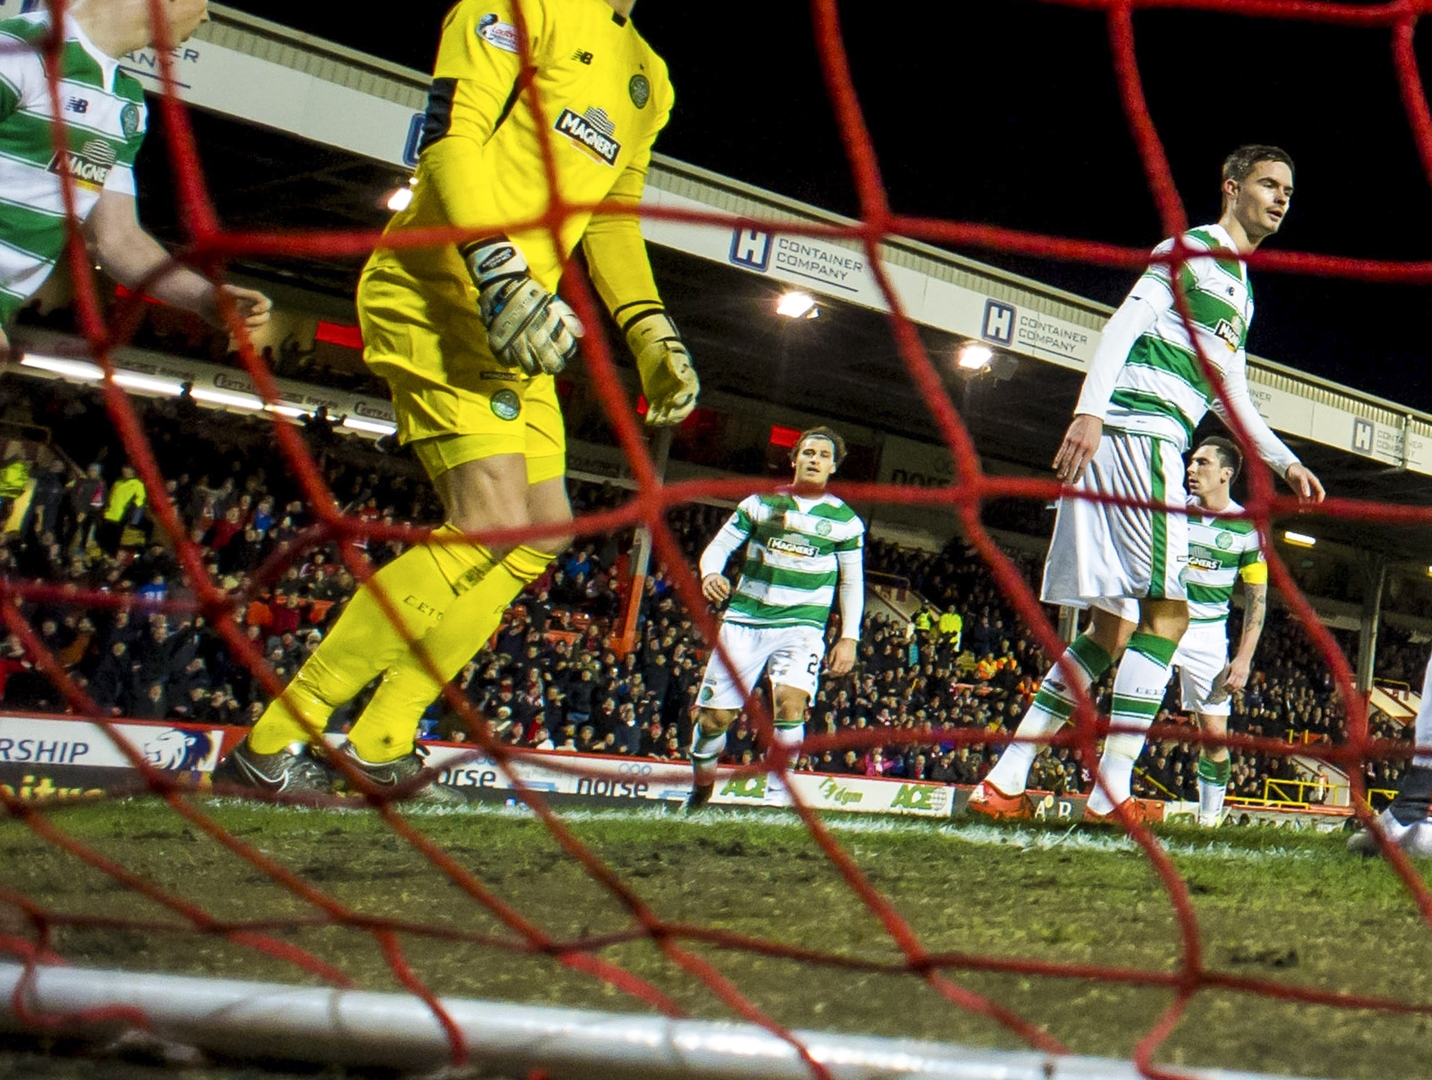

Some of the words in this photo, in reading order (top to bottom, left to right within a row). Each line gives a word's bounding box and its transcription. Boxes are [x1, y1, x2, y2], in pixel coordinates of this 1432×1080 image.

[560, 111, 619, 161] MAGNERS
[776, 251, 850, 281] COMPANY
[778, 238, 863, 282] CONTAINER
[1017, 327, 1077, 354] COMPANY
[1019, 315, 1088, 346] CONTAINER
[1377, 429, 1423, 450] CONTANER
[438, 767, 497, 788] orse
[576, 775, 649, 798] norse
[891, 784, 937, 810] ACE
